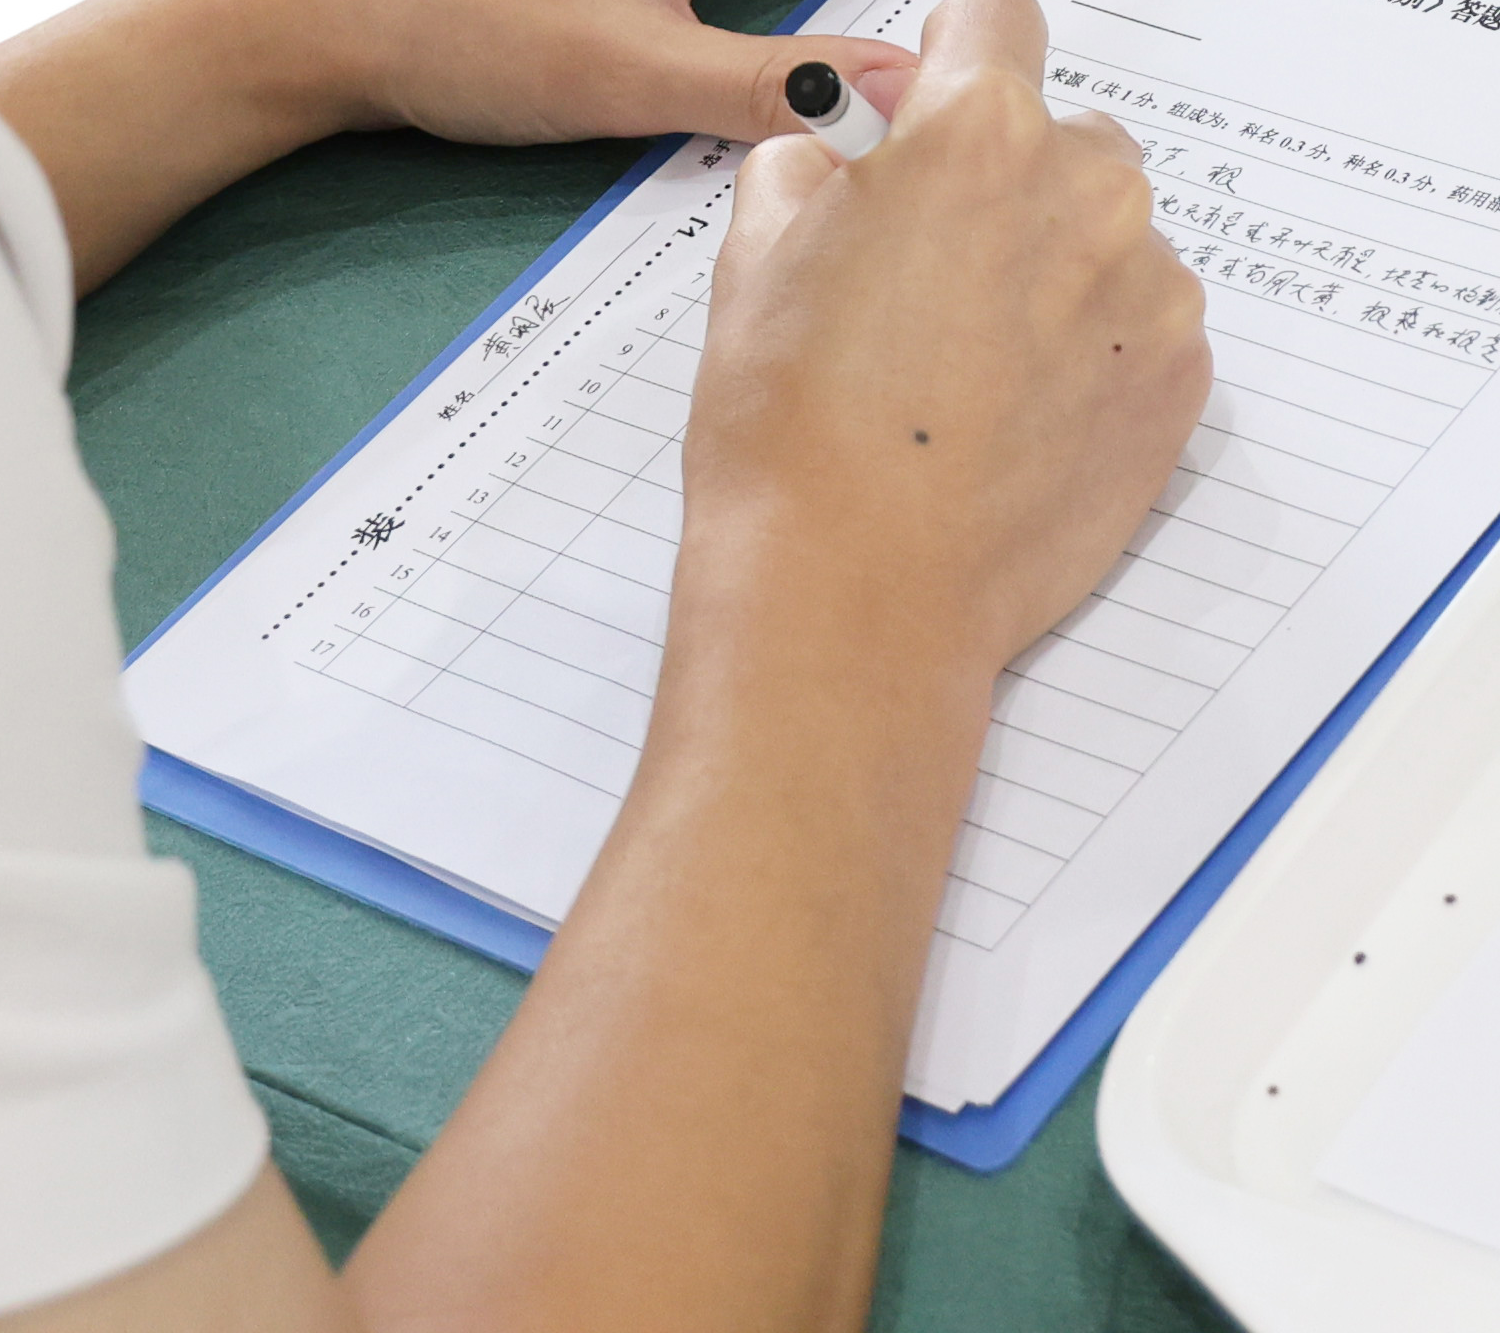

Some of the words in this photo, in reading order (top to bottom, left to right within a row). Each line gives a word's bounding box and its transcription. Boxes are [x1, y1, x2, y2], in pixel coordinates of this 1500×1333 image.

[691, 272, 706, 284] 7
[654, 308, 669, 320] 8
[617, 344, 633, 355] 9
[578, 379, 602, 396] 10
[437, 390, 476, 422] 姓名
[542, 415, 563, 430] 11
[504, 452, 528, 469] 12
[466, 489, 491, 505] 13
[350, 512, 406, 550] 装
[429, 526, 454, 543] 14
[390, 565, 416, 581] 15
[351, 602, 375, 619] 16
[311, 640, 337, 655] 17
